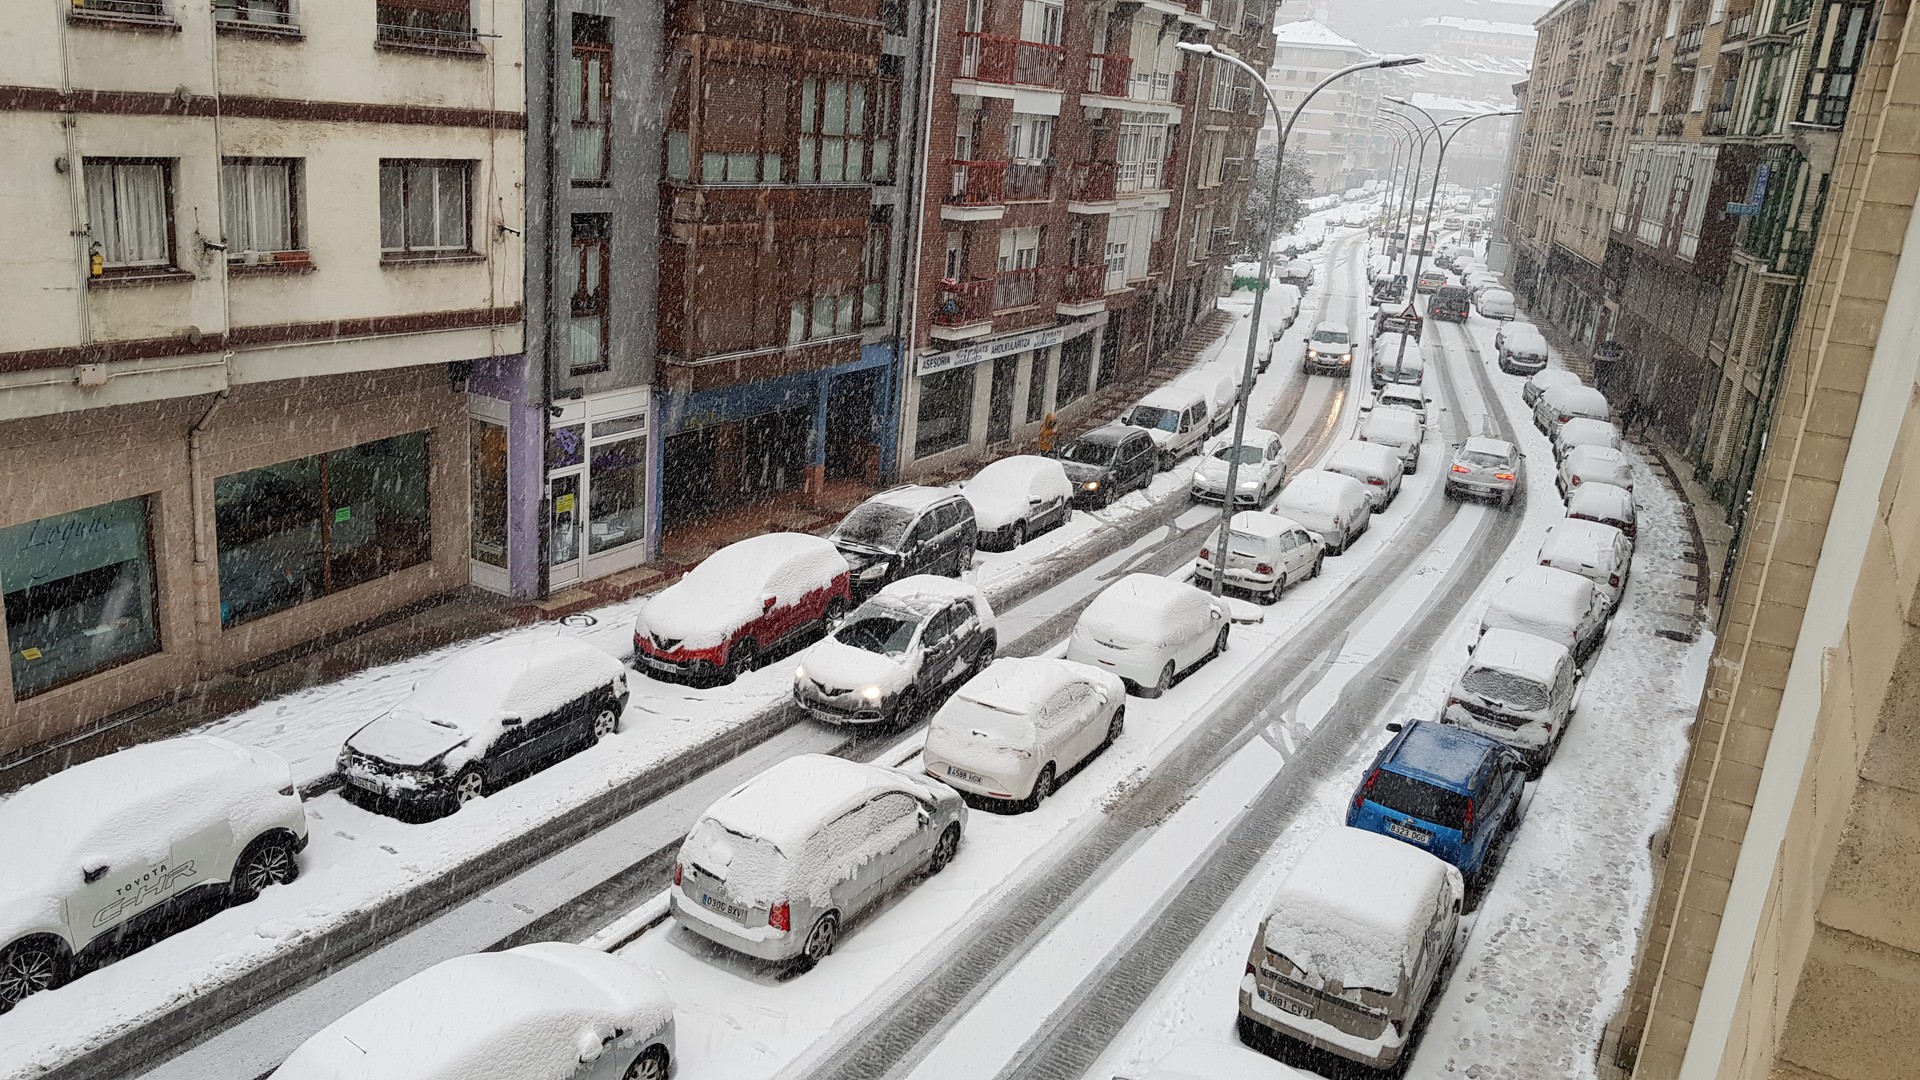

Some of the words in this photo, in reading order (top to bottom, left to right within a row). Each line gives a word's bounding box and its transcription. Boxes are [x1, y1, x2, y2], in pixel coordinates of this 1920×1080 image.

[921, 354, 950, 371] ASESORIA
[1391, 823, 1409, 837] 8323
[1411, 832, 1426, 842] DGG
[116, 864, 167, 896] TOYOTA
[1266, 994, 1287, 1009] 3891
